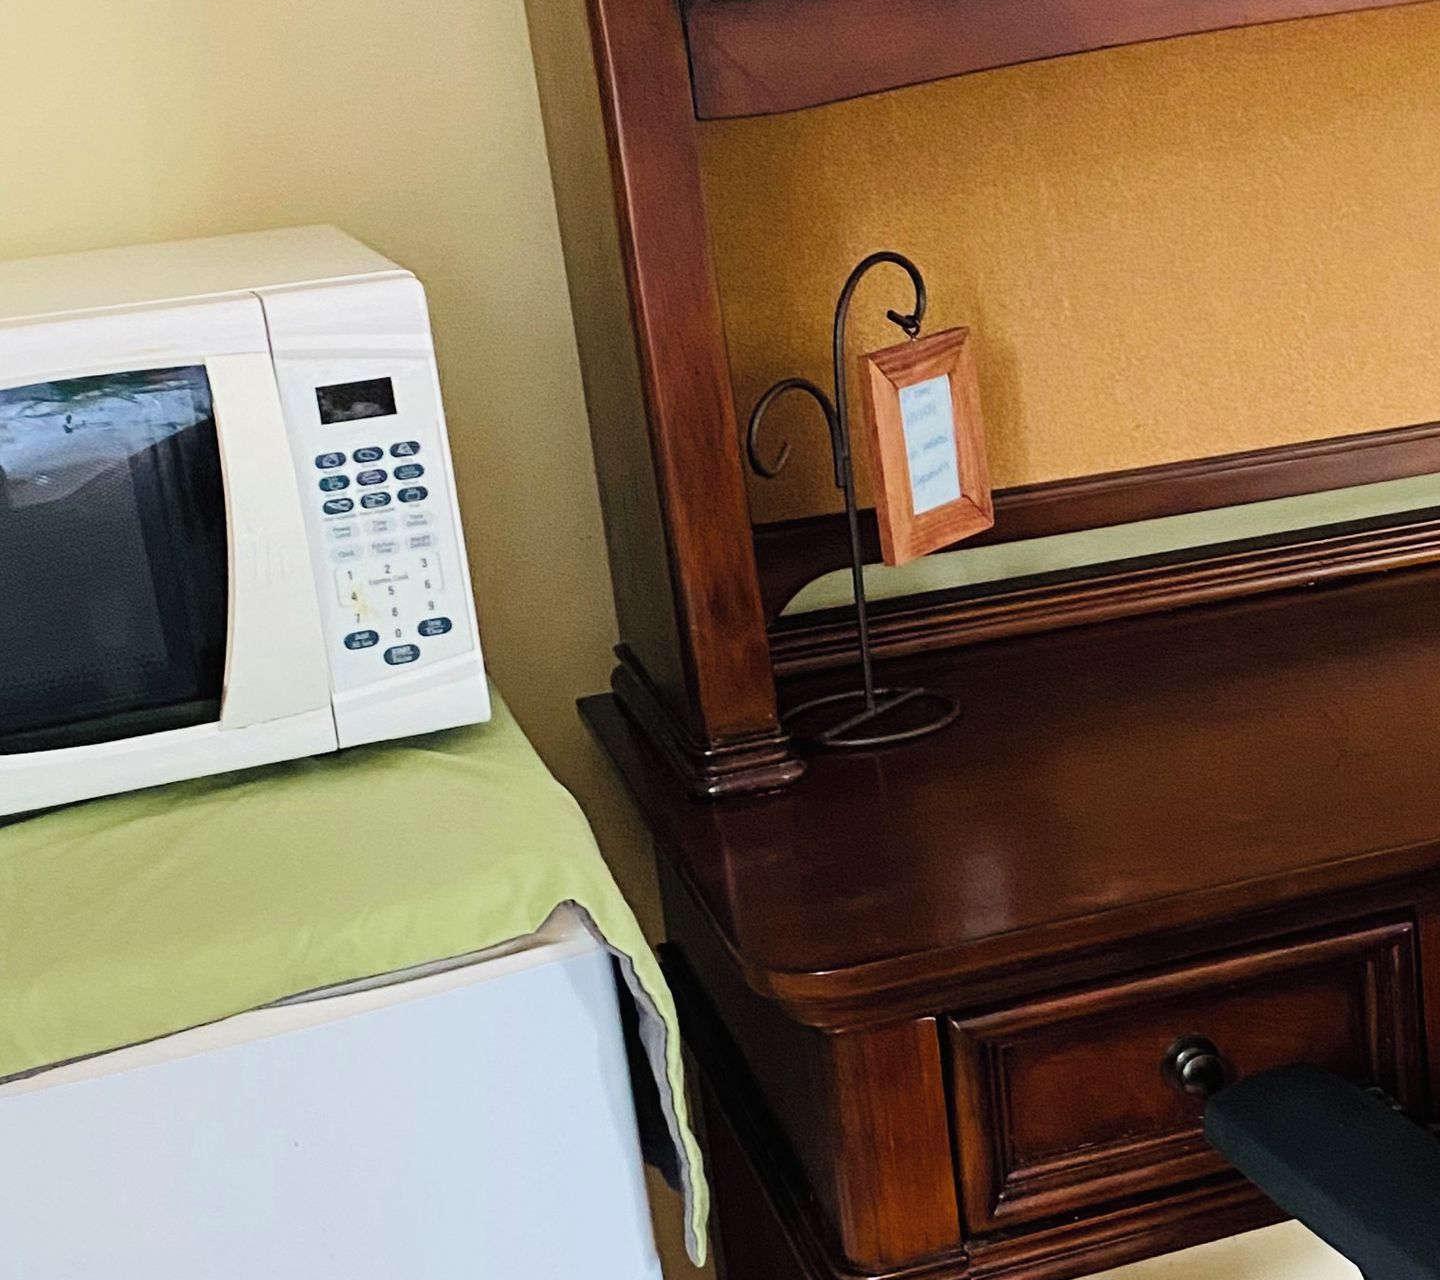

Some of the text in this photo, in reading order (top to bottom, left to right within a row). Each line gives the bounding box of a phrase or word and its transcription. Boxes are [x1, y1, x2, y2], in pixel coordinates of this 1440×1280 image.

[421, 558, 428, 568] 3
[384, 564, 391, 574] 2
[347, 570, 353, 580] 1
[424, 579, 431, 589] 6
[388, 585, 395, 595] 5
[351, 591, 358, 600] 4
[428, 600, 435, 611] 9
[355, 612, 361, 623] 7
[395, 628, 402, 638] 0
